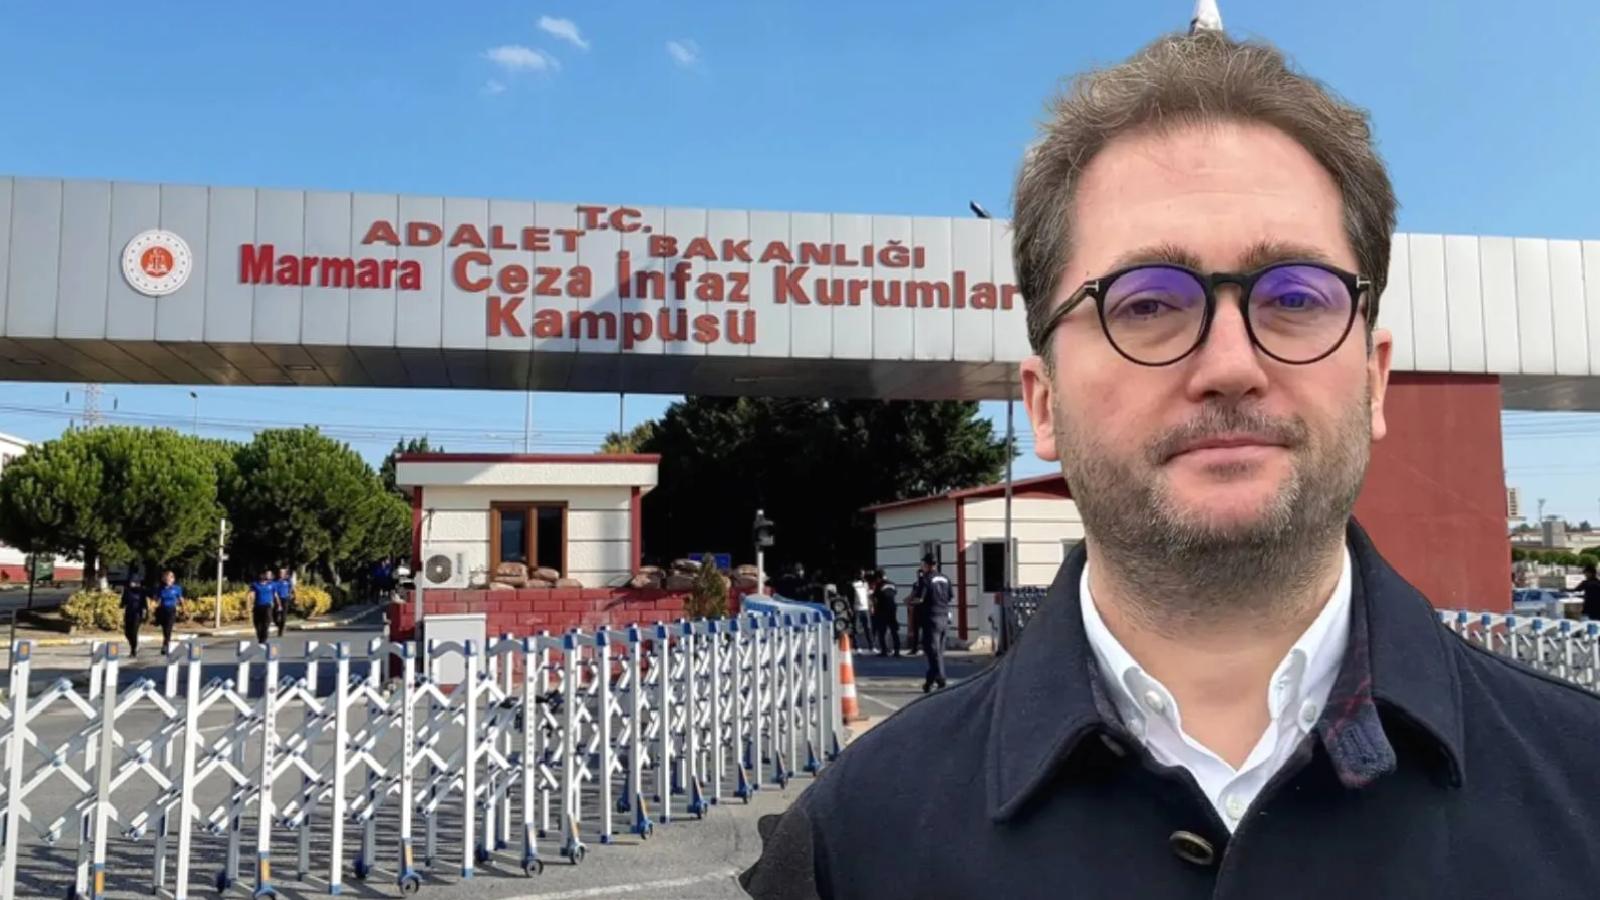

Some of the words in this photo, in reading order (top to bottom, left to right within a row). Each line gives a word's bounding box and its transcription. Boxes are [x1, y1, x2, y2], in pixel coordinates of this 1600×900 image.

[363, 219, 586, 253] ADALET
[648, 234, 926, 269] BAKANLIĞI
[575, 206, 652, 233] T.C.
[238, 242, 423, 292] Marmara
[452, 248, 594, 299] Ceza
[617, 249, 751, 304] İnfaz
[485, 295, 757, 350] Kampüsü
